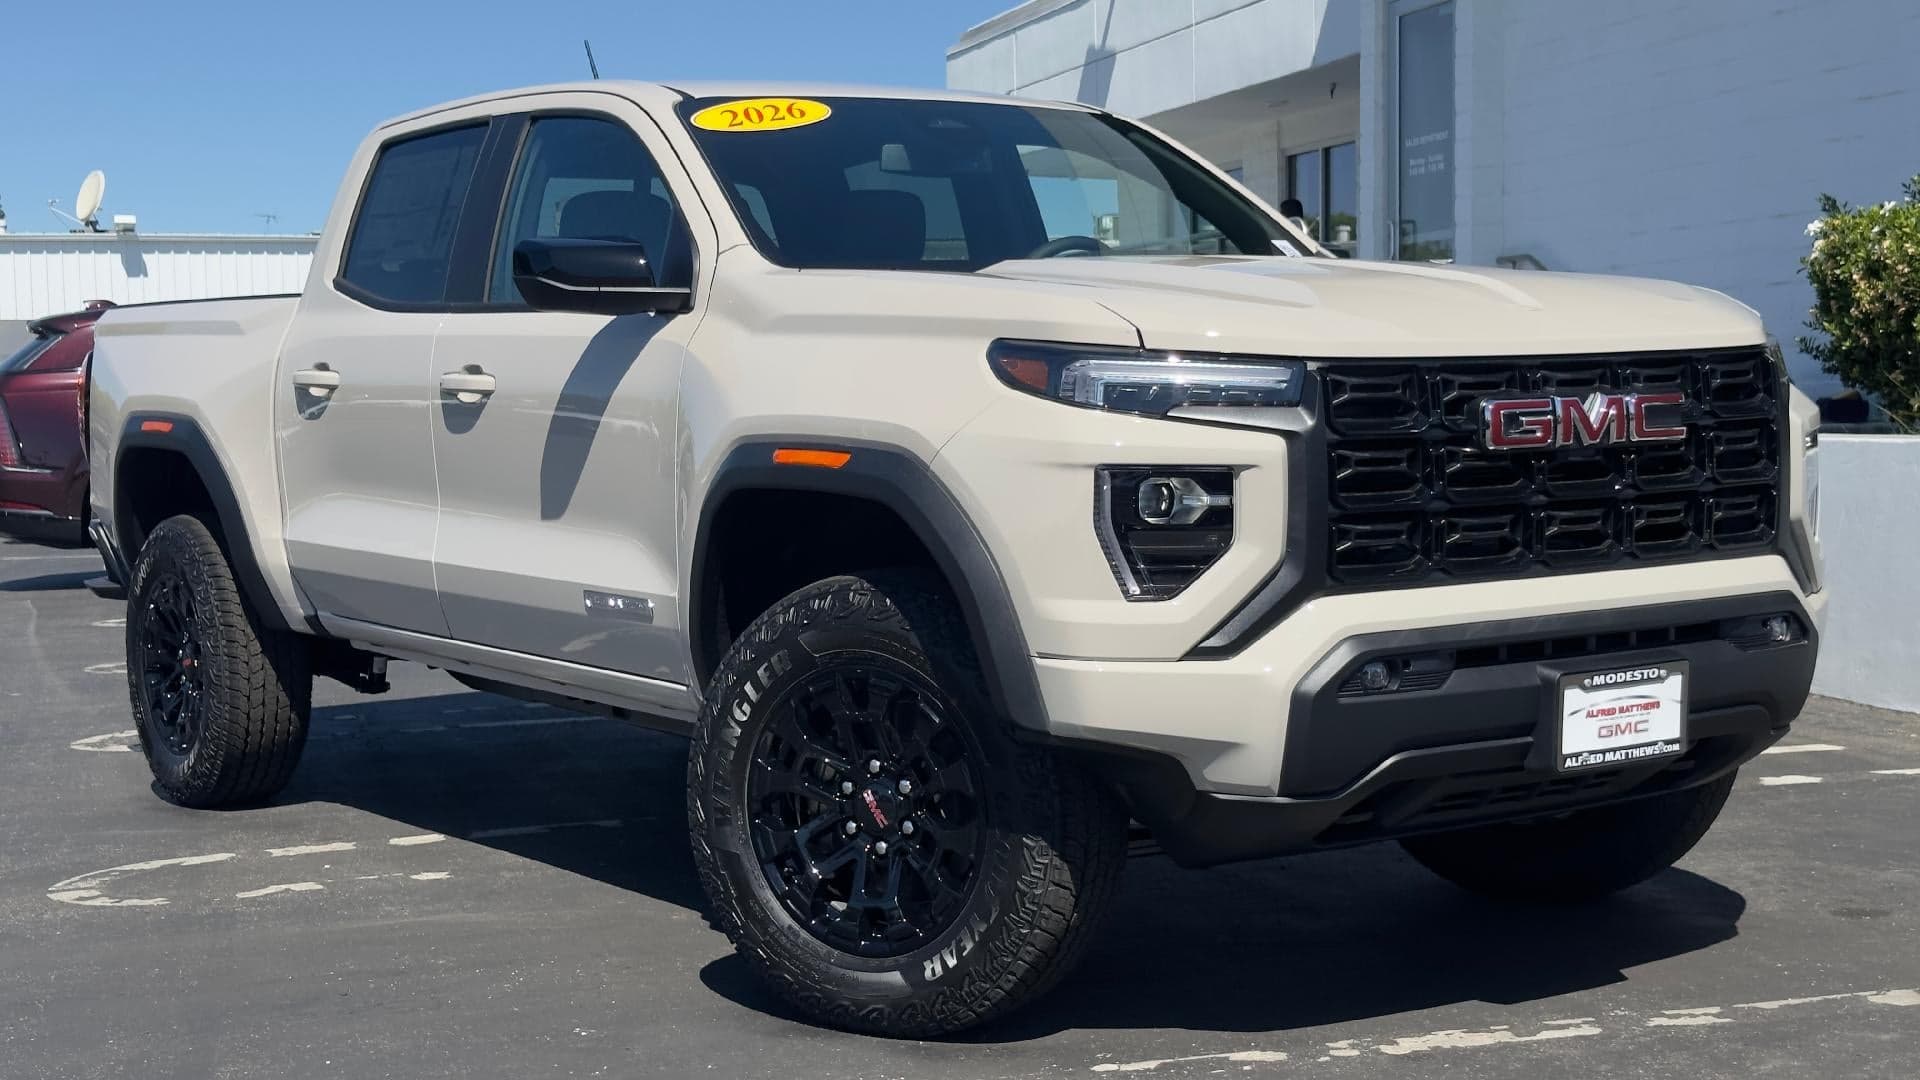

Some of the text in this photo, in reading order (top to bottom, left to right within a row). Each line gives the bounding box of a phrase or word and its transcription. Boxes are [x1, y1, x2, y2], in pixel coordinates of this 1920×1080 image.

[720, 102, 806, 128] 2026
[1481, 392, 1687, 450] GMC
[1592, 668, 1659, 686] MODESTO
[1586, 707, 1616, 719] ALFRED
[1618, 701, 1660, 714] MATTHEWS
[1598, 720, 1649, 738] GMC
